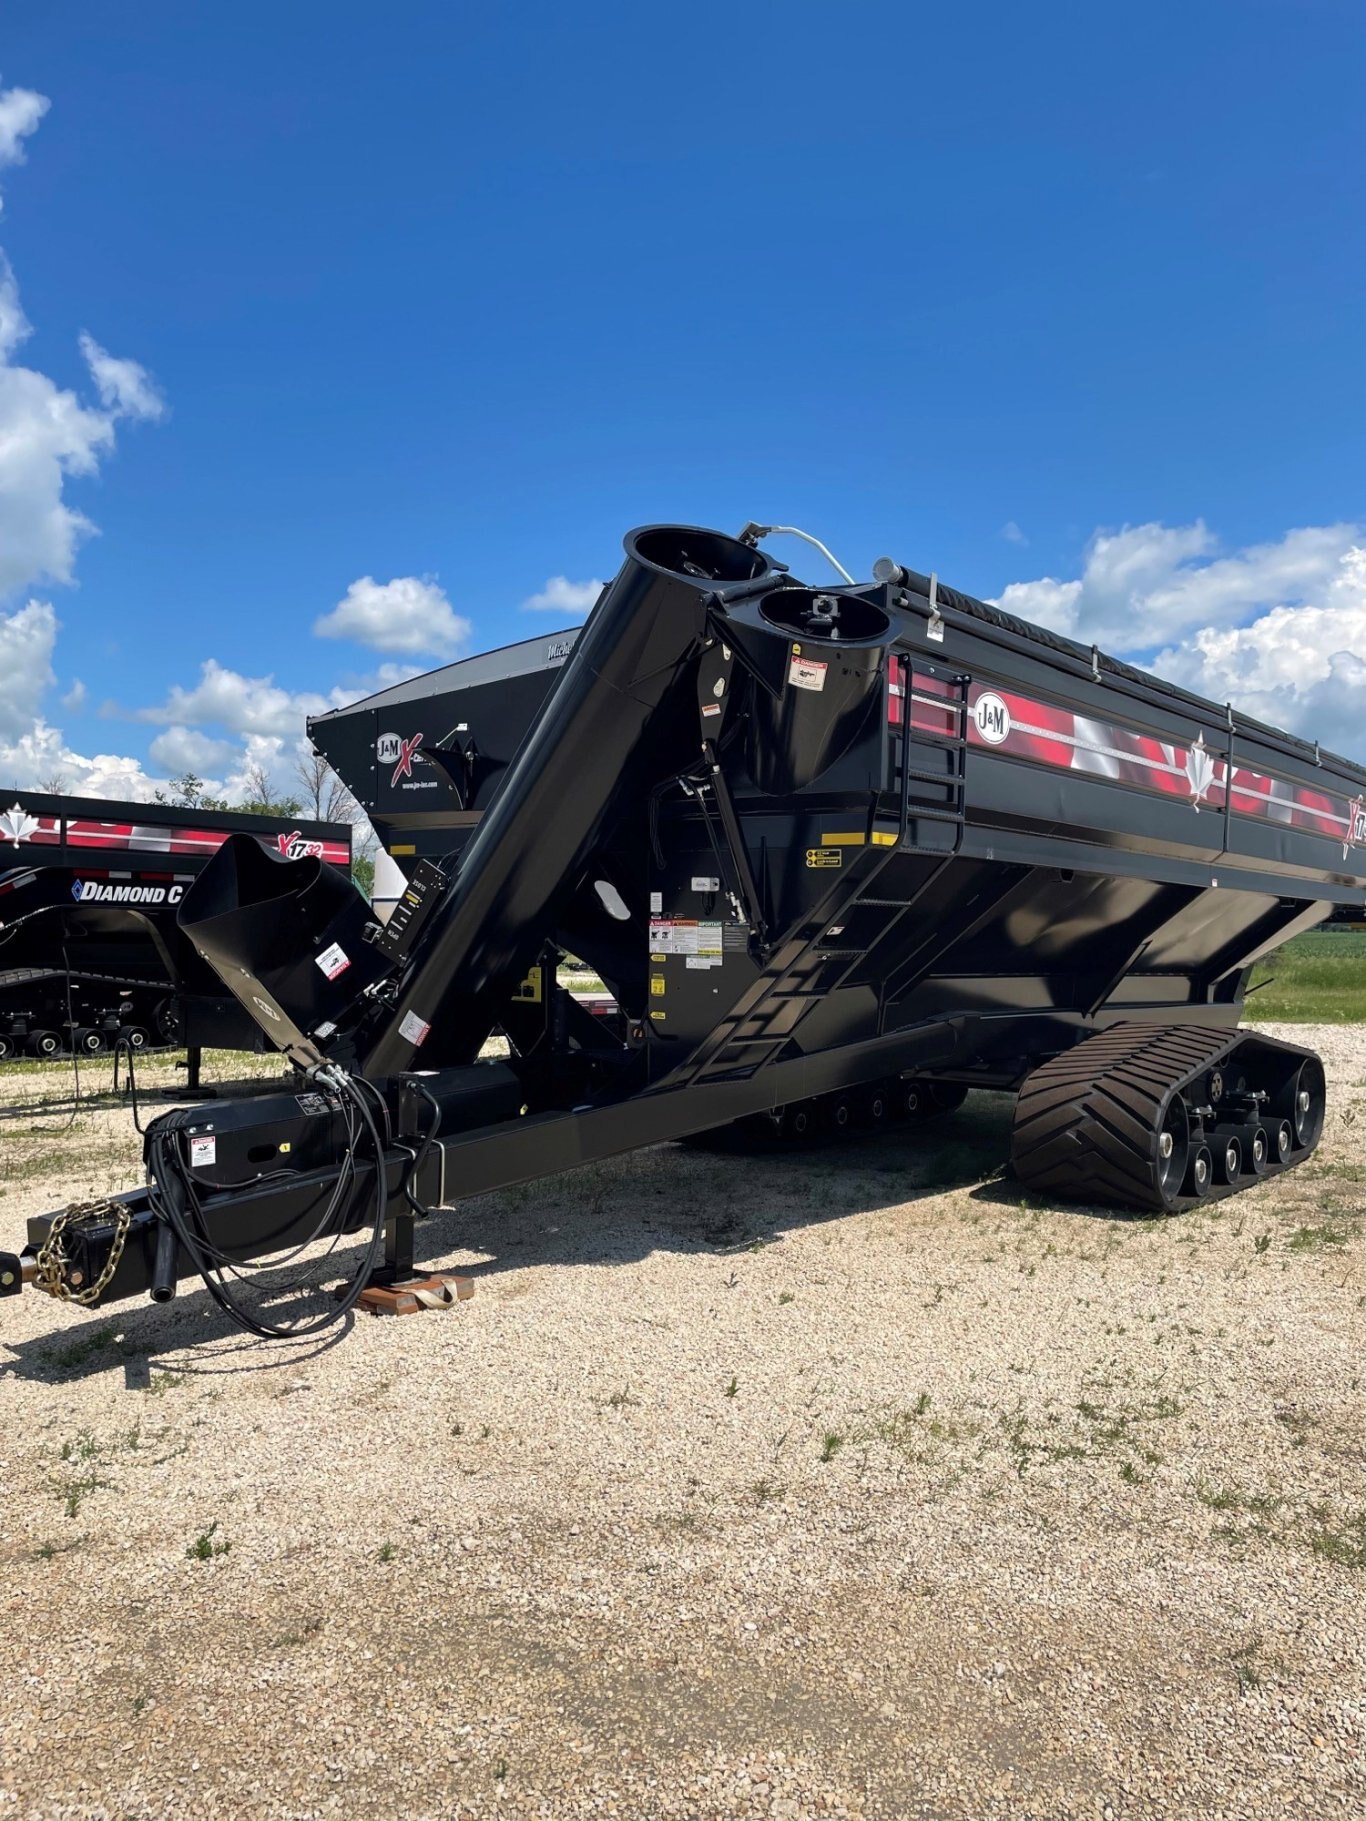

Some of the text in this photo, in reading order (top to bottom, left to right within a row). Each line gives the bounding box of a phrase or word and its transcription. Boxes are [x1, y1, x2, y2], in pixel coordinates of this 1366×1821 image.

[978, 703, 1004, 735] J&M
[379, 740, 399, 757] J&M
[80, 881, 183, 904] DIAMOND C
